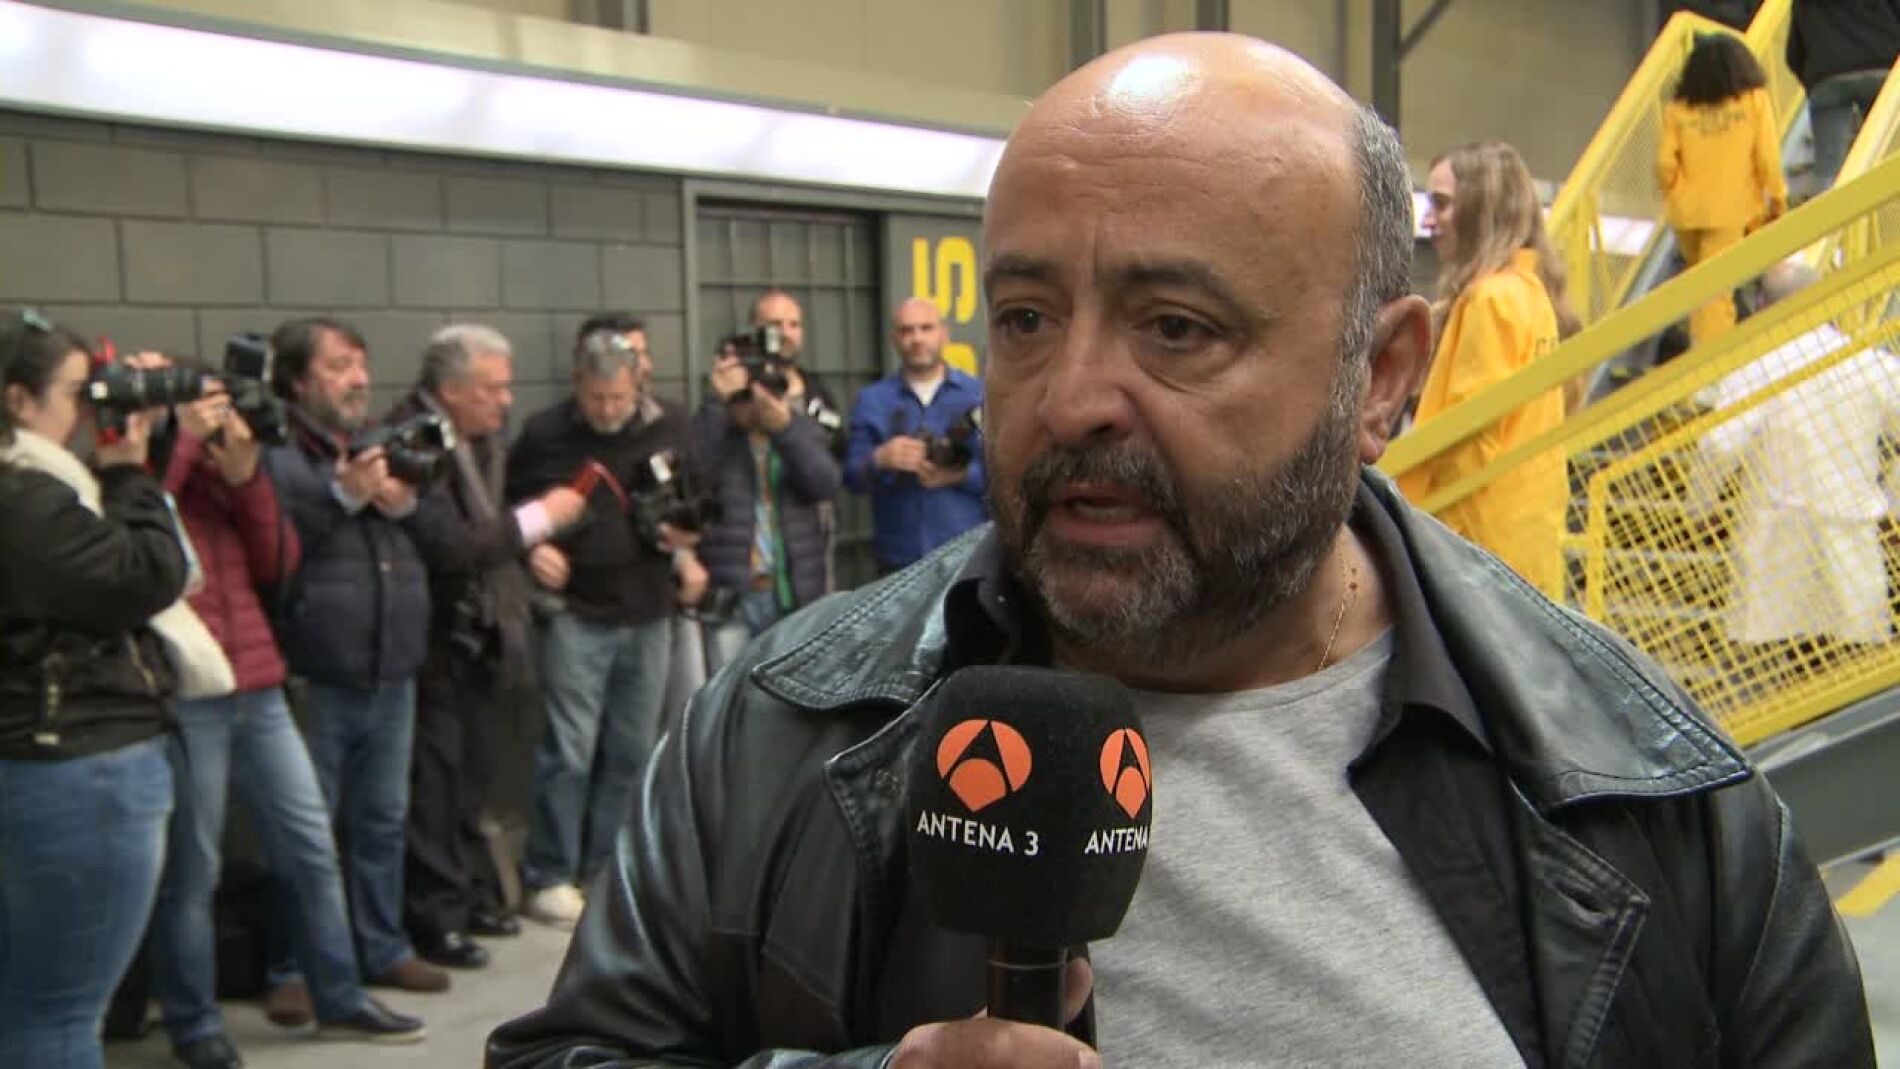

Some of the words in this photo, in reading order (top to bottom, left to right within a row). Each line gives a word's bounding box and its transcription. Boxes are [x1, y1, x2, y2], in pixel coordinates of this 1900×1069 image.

[917, 809, 1014, 853] ANTENA
[1023, 830, 1039, 856] 3
[1084, 825, 1149, 854] ANTENA
